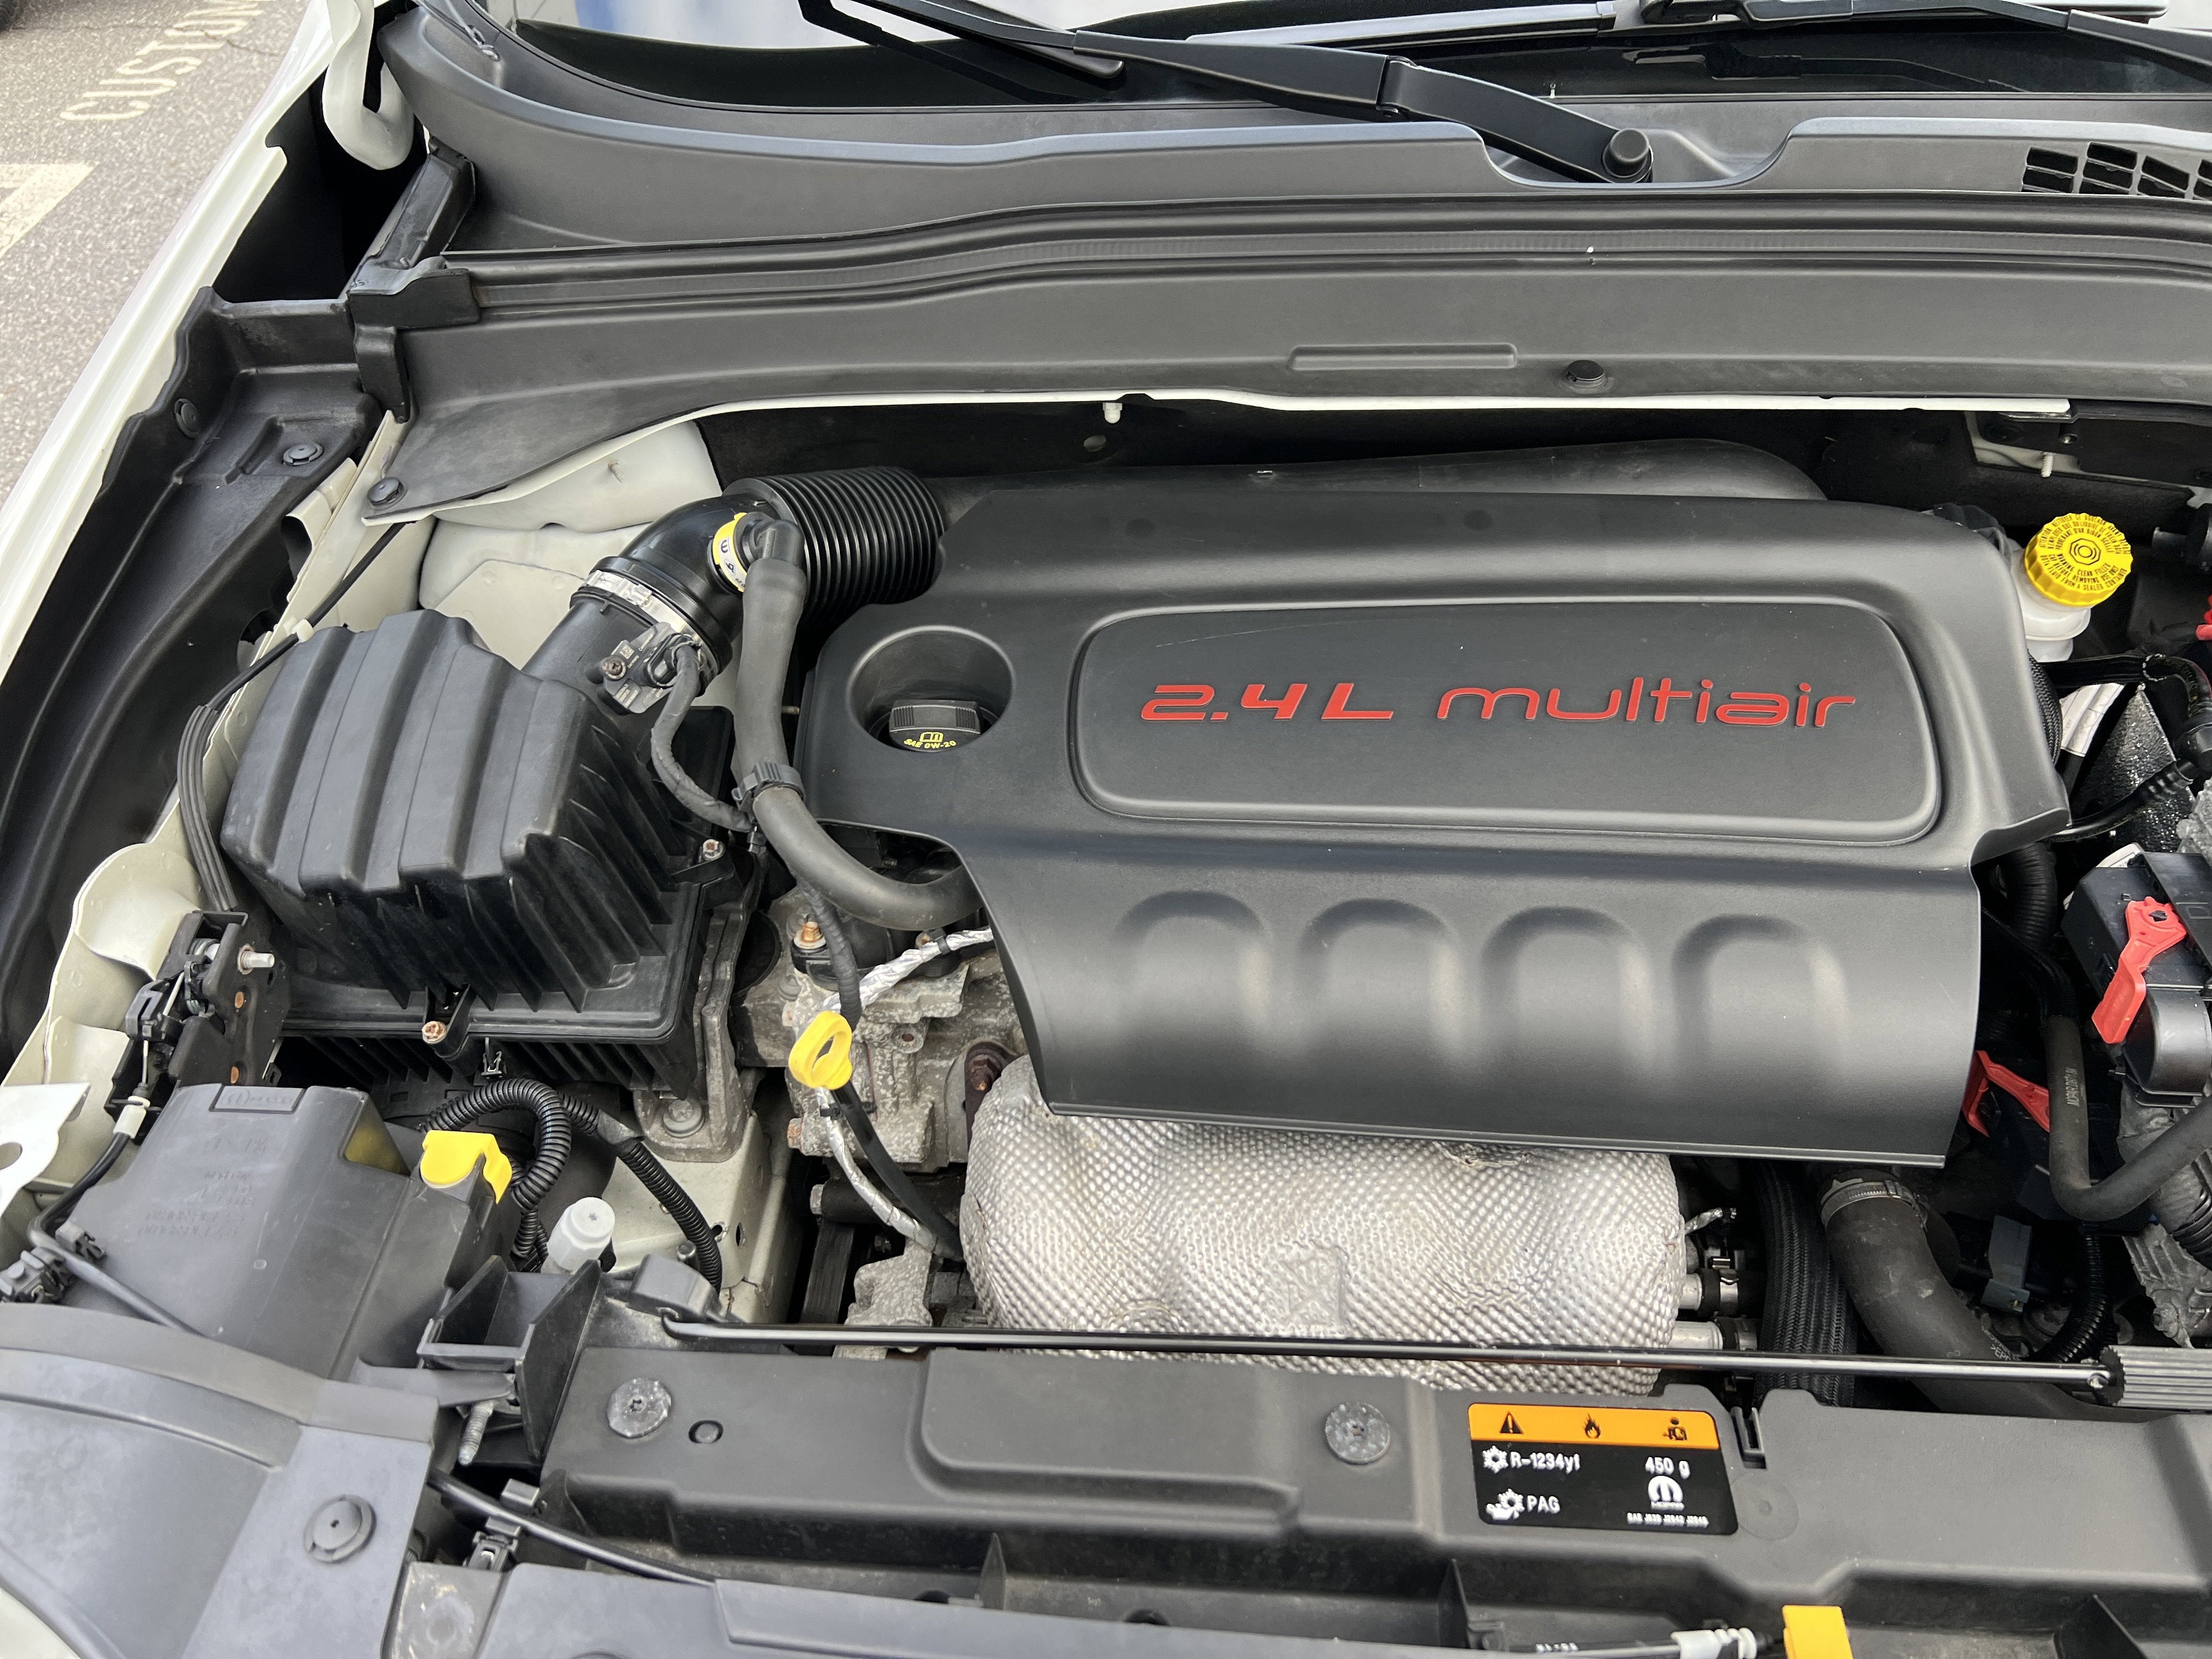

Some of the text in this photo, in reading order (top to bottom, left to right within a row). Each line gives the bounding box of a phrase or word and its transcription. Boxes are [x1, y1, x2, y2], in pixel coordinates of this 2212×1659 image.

[1437, 678, 1855, 726] multiair
[904, 738, 957, 749] SAE 0W-20
[1645, 1457, 1690, 1479] 450 g
[1527, 1496, 1560, 1513] PAG
